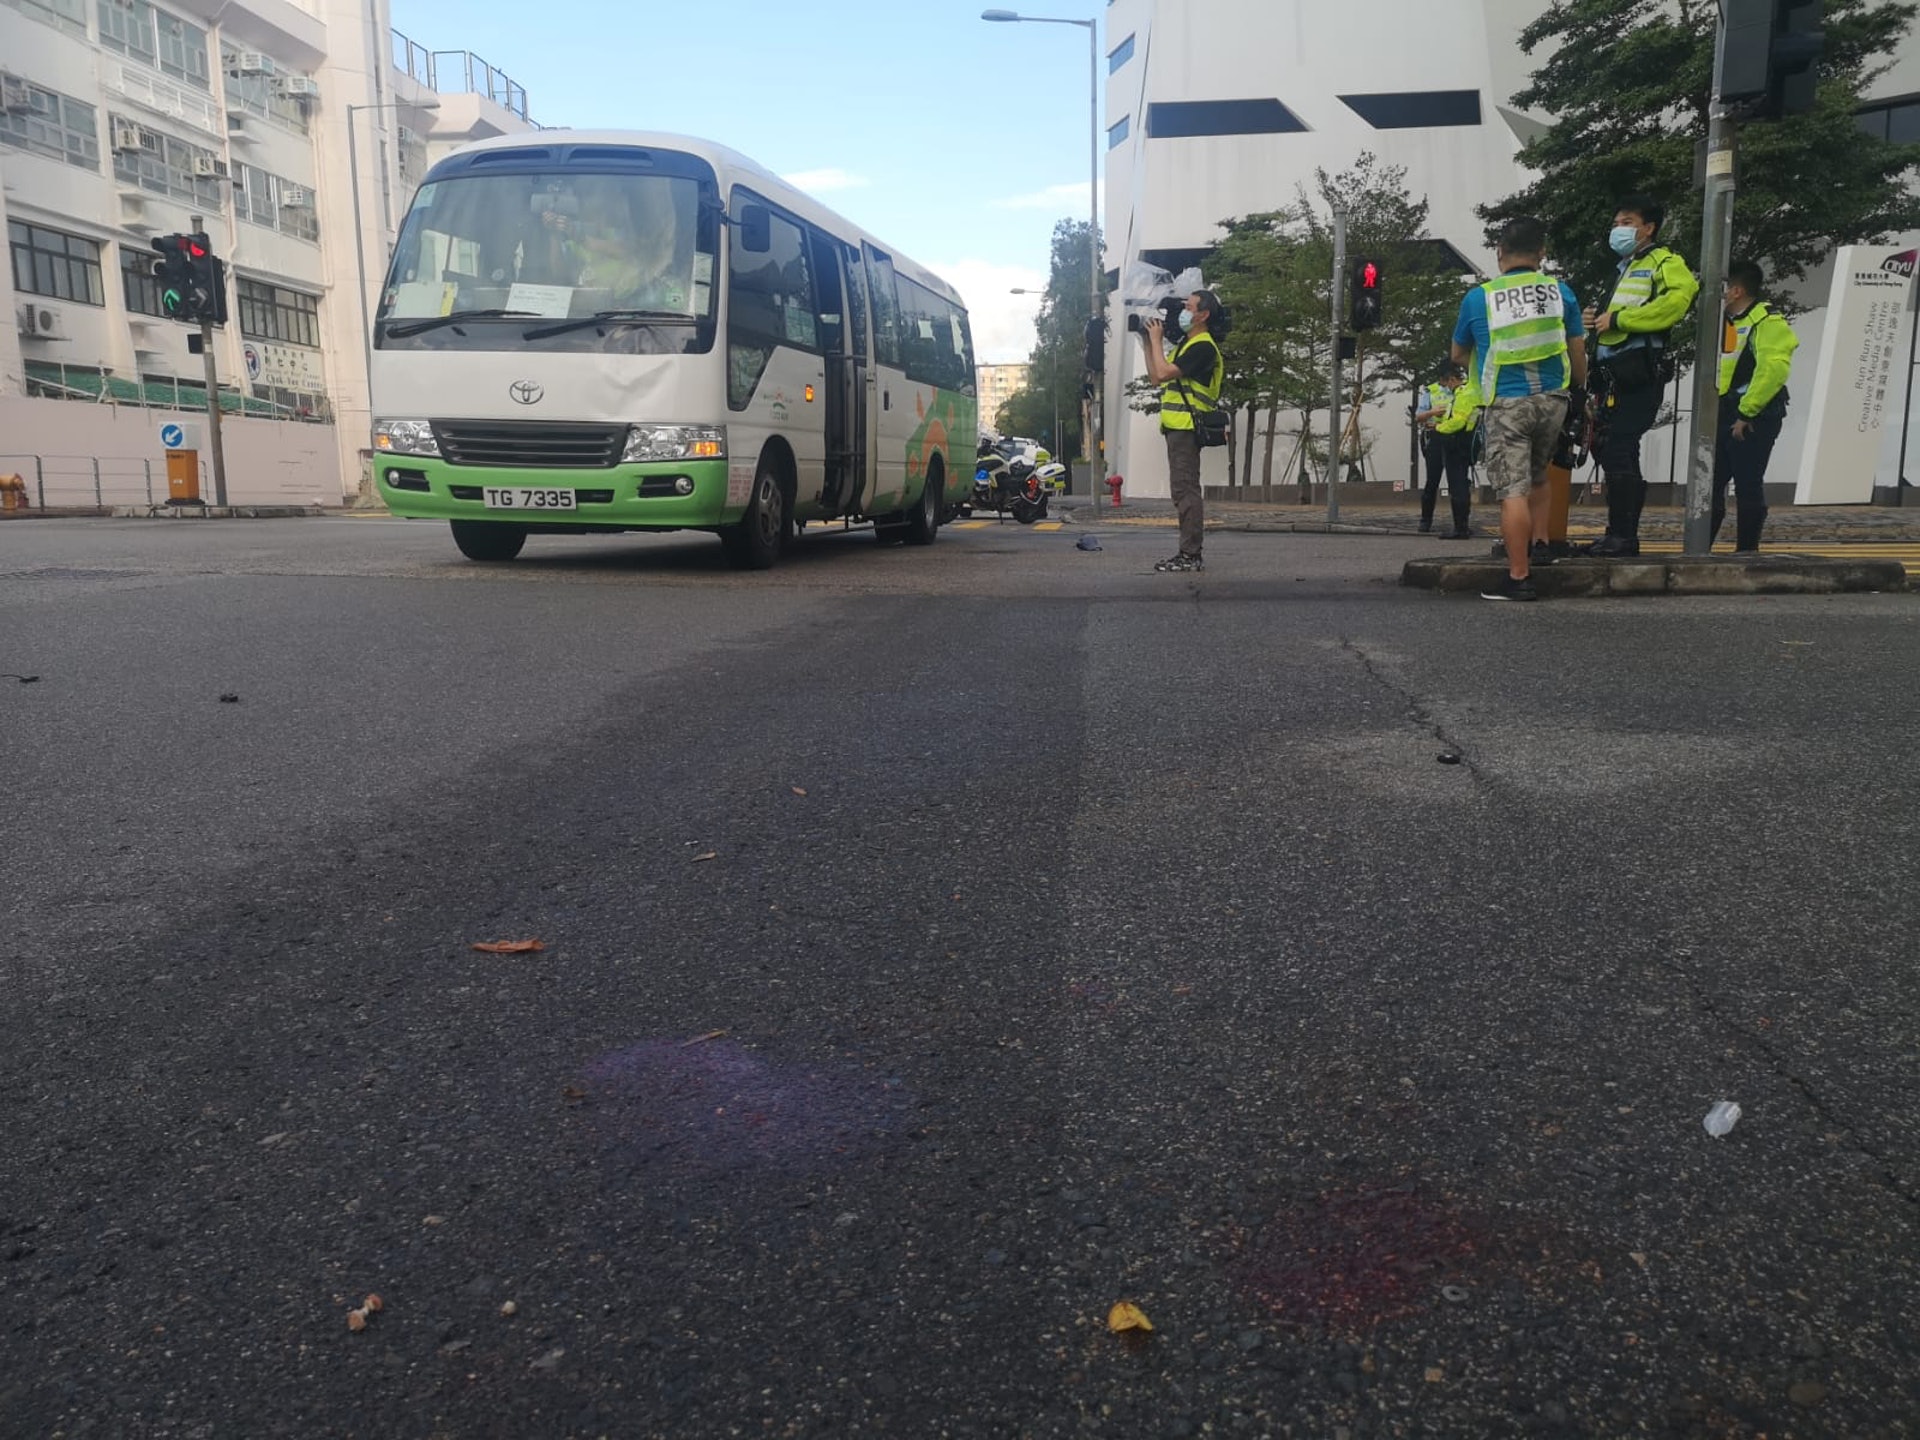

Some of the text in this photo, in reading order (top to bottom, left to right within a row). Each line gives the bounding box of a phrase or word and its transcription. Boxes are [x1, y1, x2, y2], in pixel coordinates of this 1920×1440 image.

[1495, 284, 1559, 311] PRESS
[487, 489, 572, 507] TG 7335
